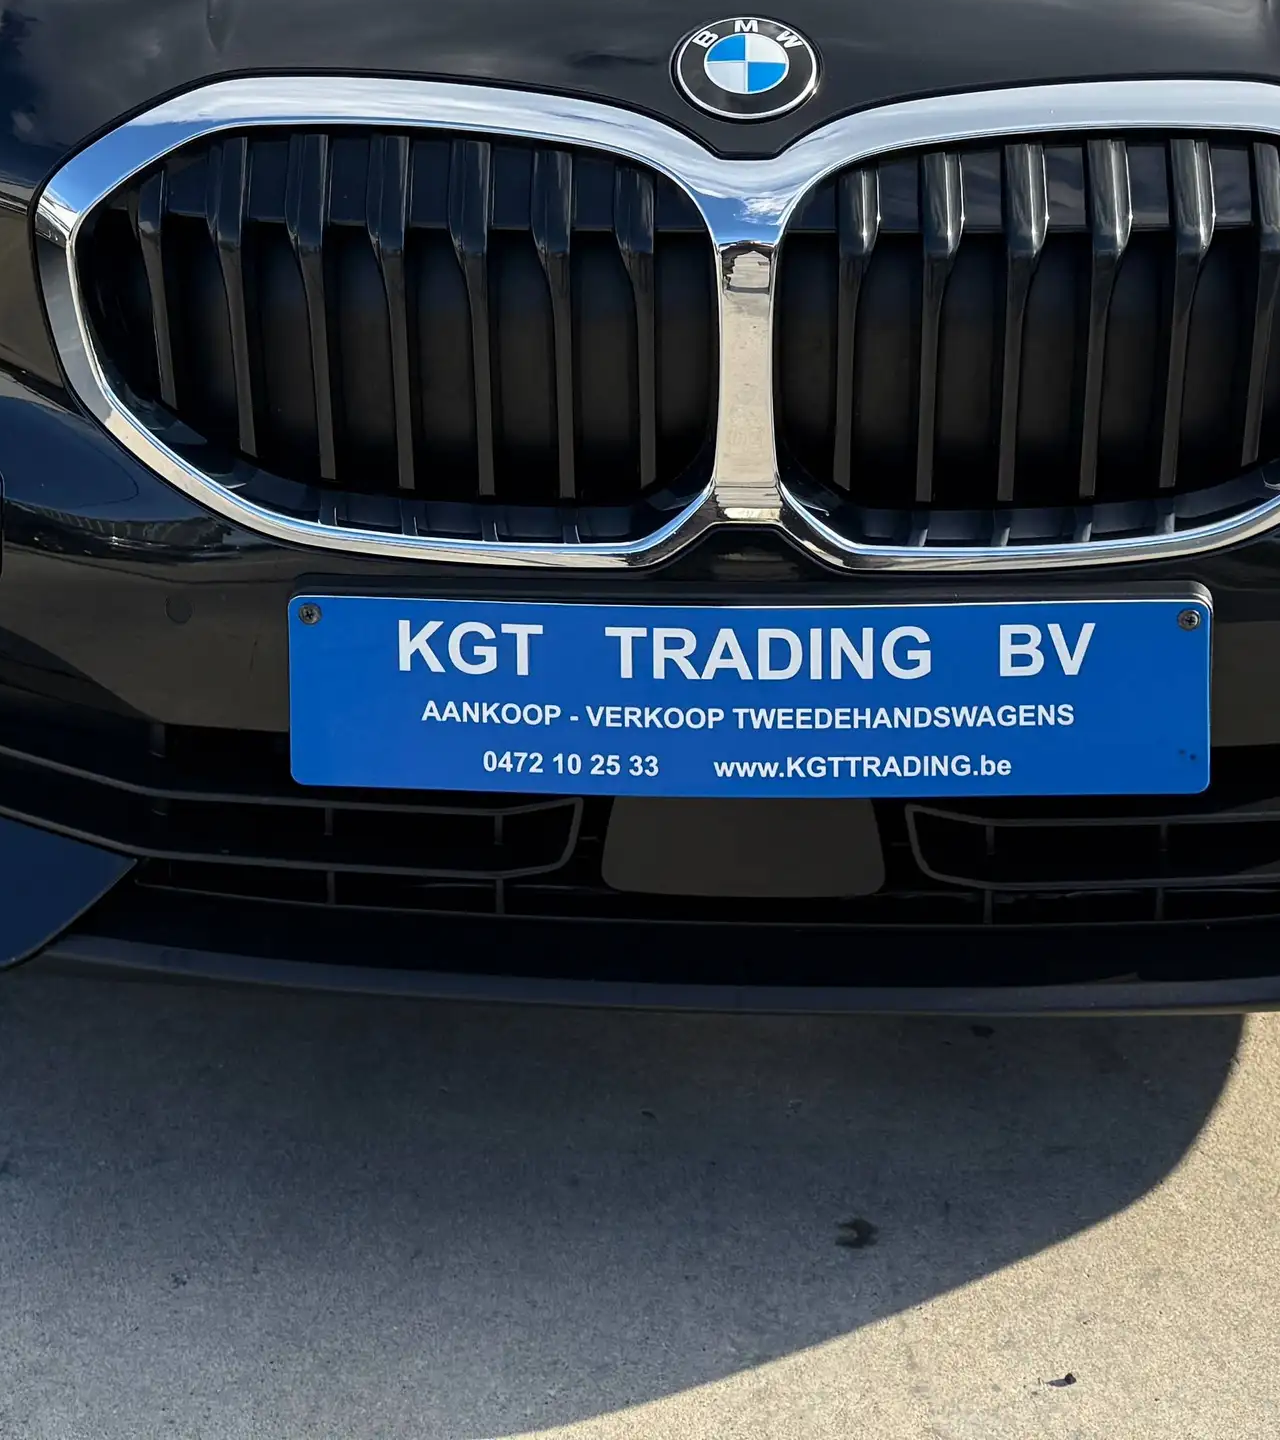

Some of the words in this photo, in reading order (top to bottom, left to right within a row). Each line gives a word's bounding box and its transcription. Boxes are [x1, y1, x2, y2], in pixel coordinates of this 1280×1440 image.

[691, 18, 804, 50] BMW
[397, 619, 544, 677] KGT
[604, 624, 932, 681] TRADING
[998, 622, 1097, 678] BV
[420, 700, 562, 727] AANKOOP
[585, 704, 726, 730] VERKOOP
[732, 704, 1074, 730] TWEEDEHANDSWAGENS
[483, 750, 545, 773] 0472
[553, 753, 582, 775] 10
[590, 754, 621, 776] 25
[628, 755, 660, 778] 33
[713, 754, 1012, 779] www.KGTTRADING.be
